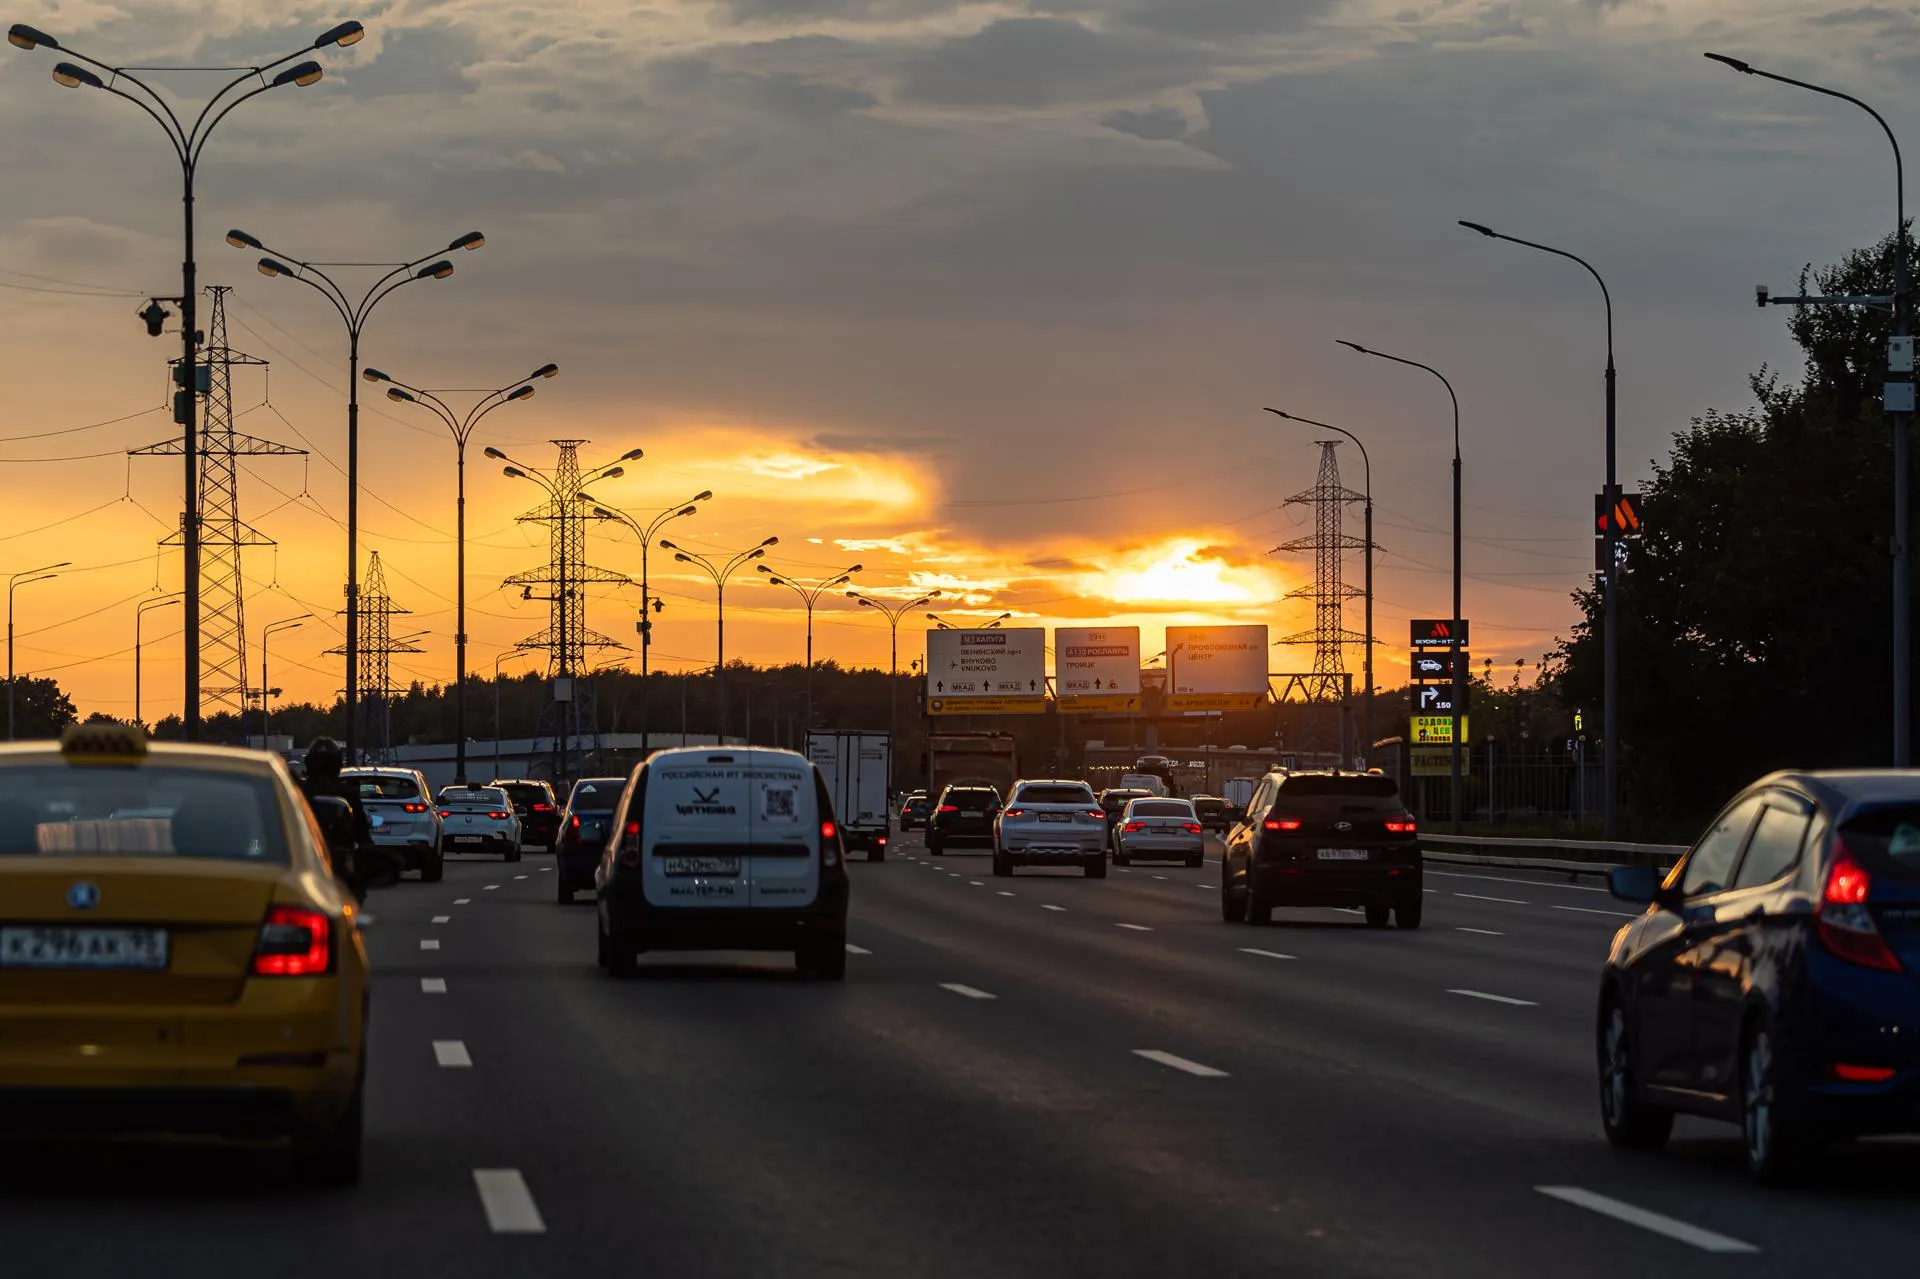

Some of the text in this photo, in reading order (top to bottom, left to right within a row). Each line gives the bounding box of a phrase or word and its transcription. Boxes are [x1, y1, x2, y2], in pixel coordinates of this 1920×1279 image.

[976, 635, 1005, 643] КАЛУГА
[961, 648, 1005, 656] ЛЕНИНСКИЙ
[1188, 653, 1213, 661] ЦЕНТР
[953, 683, 974, 691] МКАД
